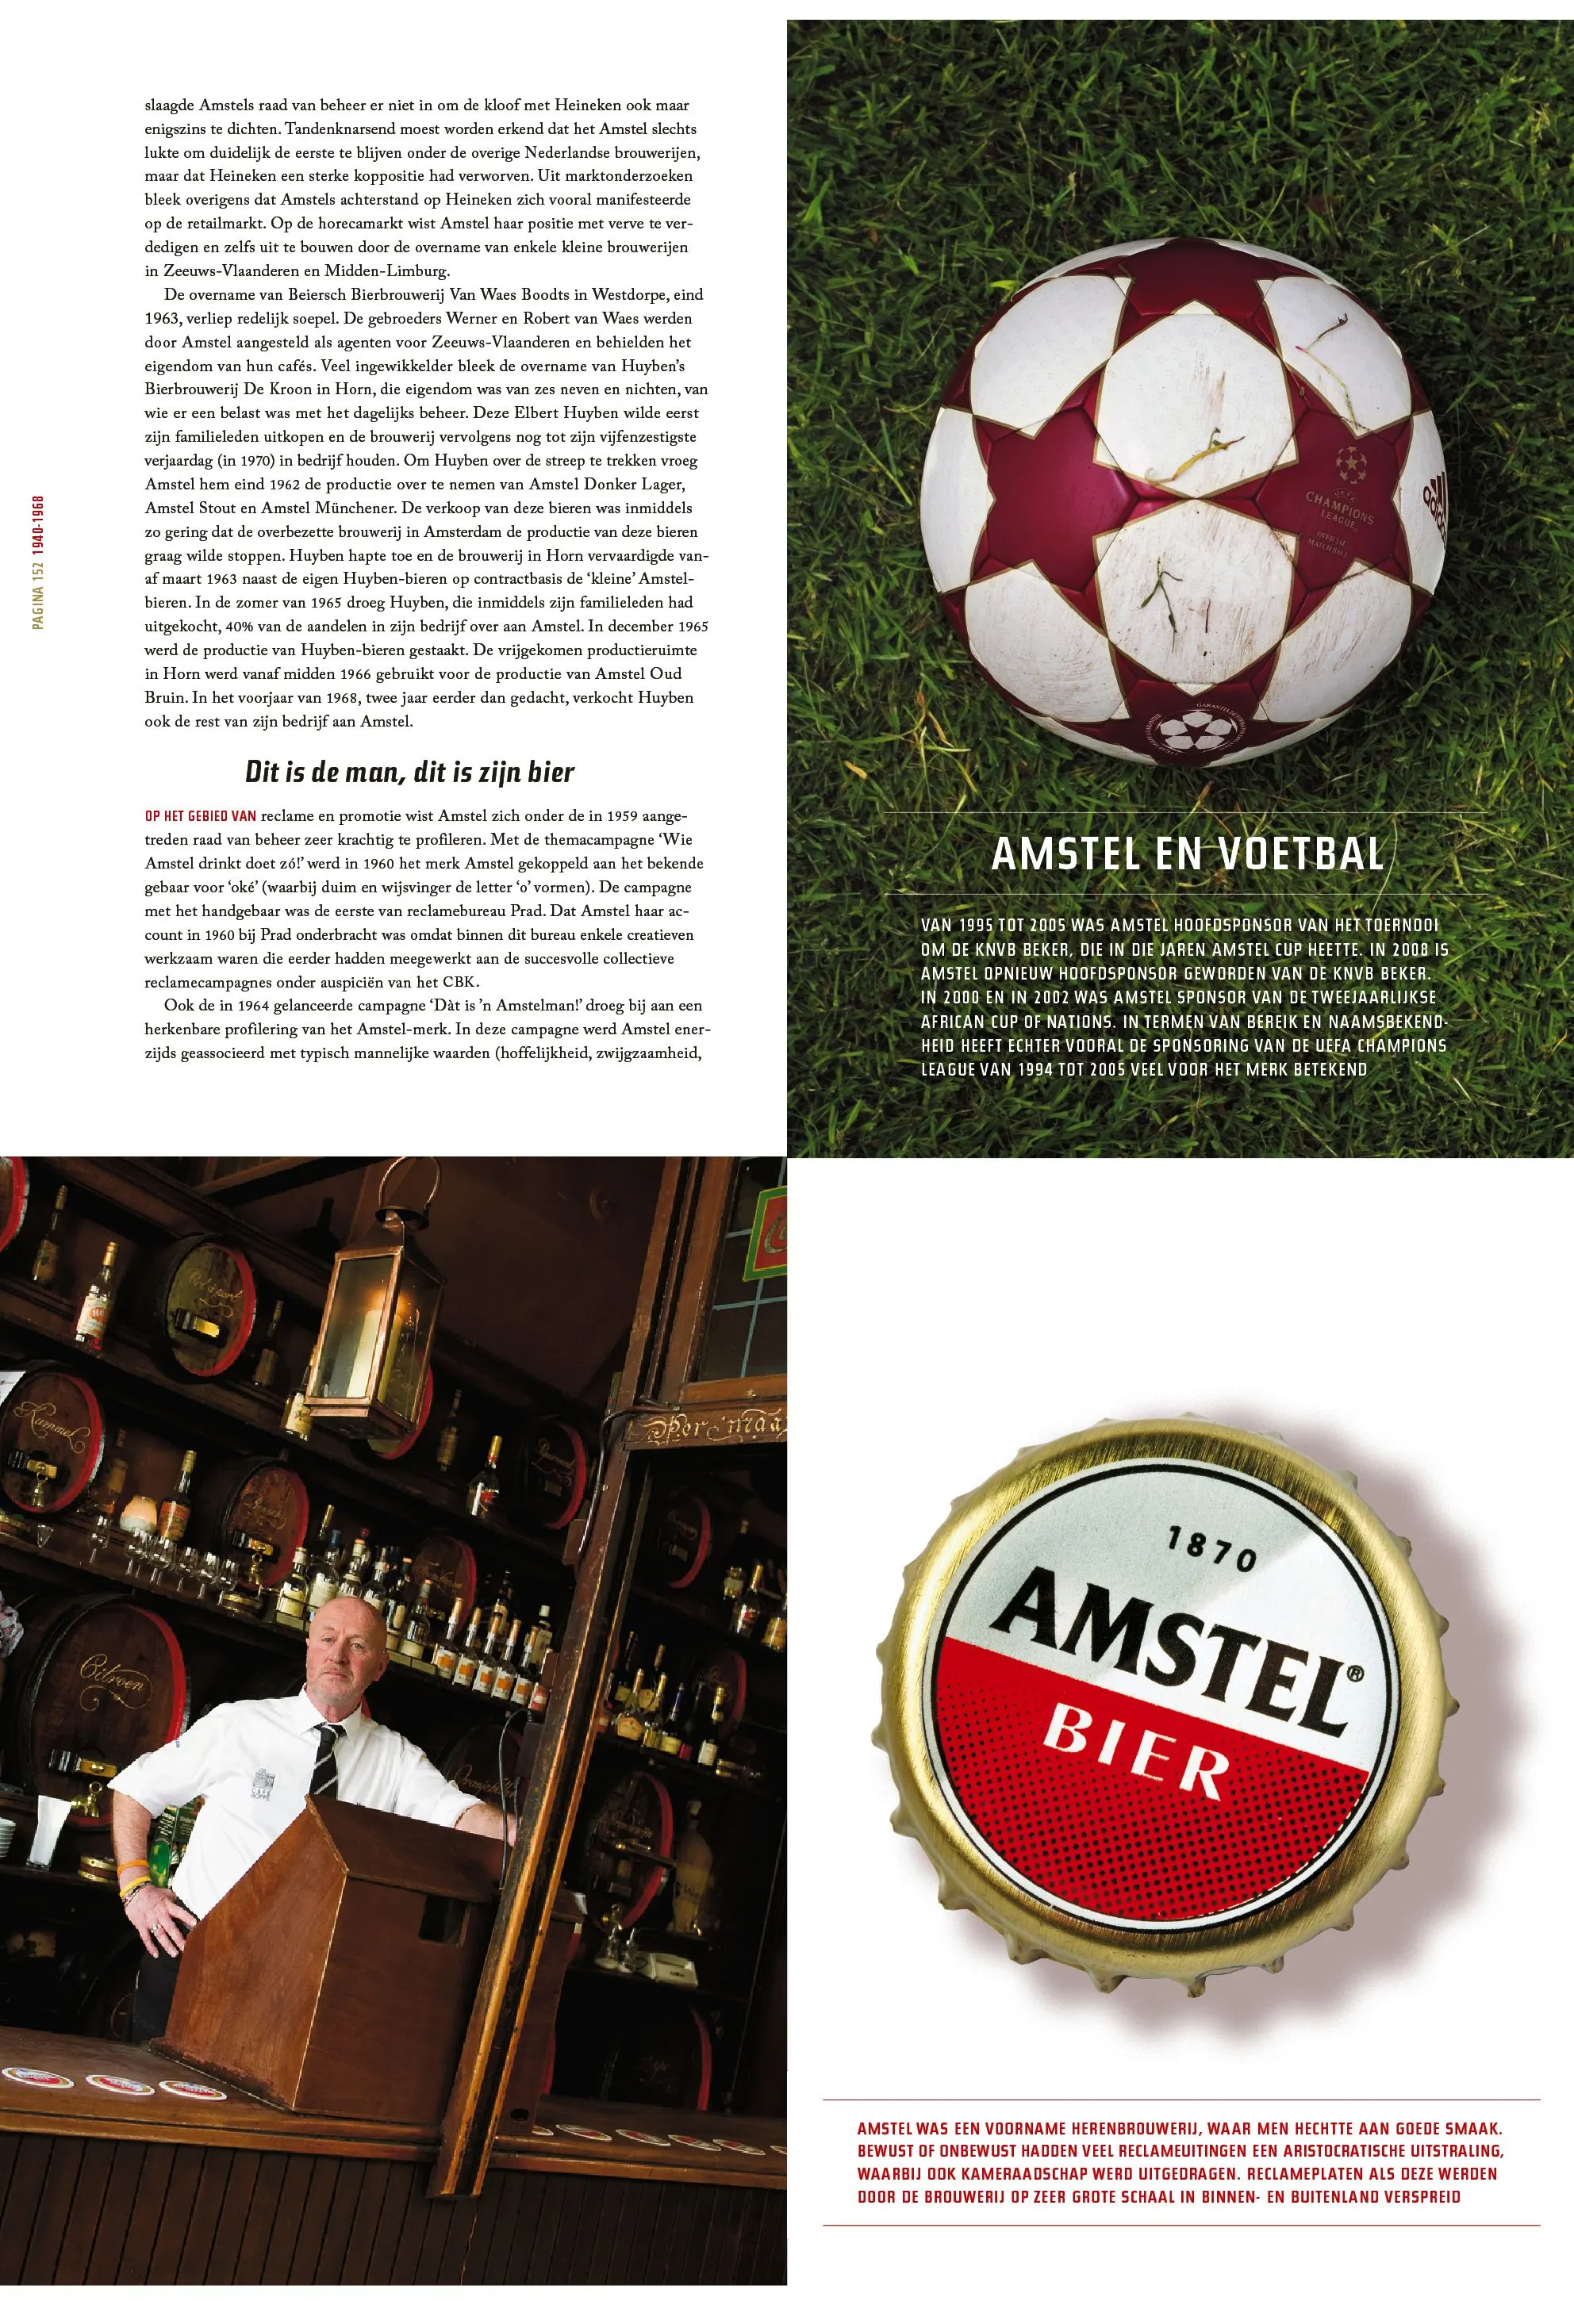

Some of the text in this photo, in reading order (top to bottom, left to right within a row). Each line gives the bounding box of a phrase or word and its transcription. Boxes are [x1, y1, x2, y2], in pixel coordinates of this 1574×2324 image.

[144, 98, 690, 115] slaagde Amstels raad van beheer er niet in om de kloof met Heineken ook maar
[144, 192, 691, 209] bleek overigens dat Amstels achterstand op Heineken zich vooral manifesteerde
[144, 500, 693, 518] Amstel Stout en Amstel Münchener. De verkoop van deze bieren was inmiddels
[1305, 490, 1374, 525] CHAMPIONS
[1321, 509, 1356, 529] LEAGUE
[1422, 485, 1446, 550] adida
[1307, 538, 1332, 552] MATCH
[1317, 531, 1346, 547] OFFICIAL
[32, 496, 44, 630] PAGINA 152 1940-1968
[245, 759, 576, 788] Dit is de man, dit is zijn bier
[145, 808, 688, 826] OP HET GEBIED VAN reclame en promotie wist Amstel zich onder de in 1959 aange-
[991, 836, 1384, 870] AMSTEL EN VOETBAL
[920, 918, 1438, 932] VAN 1995 TOT 2005 WAS AMSTEL HOOFDSPONSOR VAN HET TOERNOOI
[920, 966, 1431, 980] AMSTEL OPNIEUW HOOFDSPONSOR GEWORDEN VAN DE KNVB BEKER.
[920, 1014, 1449, 1029] AFRICAN CUP OF NATIONS. IN TERMEN VAN BEREIK EN NAAMSBEKEND-
[144, 1045, 702, 1063] zijds geassocieerd met typisch mannelijke waarden (hoffelijkheid, zwijgzaamheid,
[1169, 1526, 1257, 1574] 1870
[80, 1653, 148, 1693] Citroen
[1043, 1703, 1230, 1801] BIER
[857, 2122, 1503, 2137] AMSTEL WAS EEN VOORNAME HERENBROUWERIJ, WAAR MEN HECHTTE AAN GOEDE SMAAK.
[858, 2190, 1461, 2203] DOOR DE BROUWERIJ OP ZEER GROTE SCHAAL IN BINNEN- EN BUITENLAND VERSPREID
